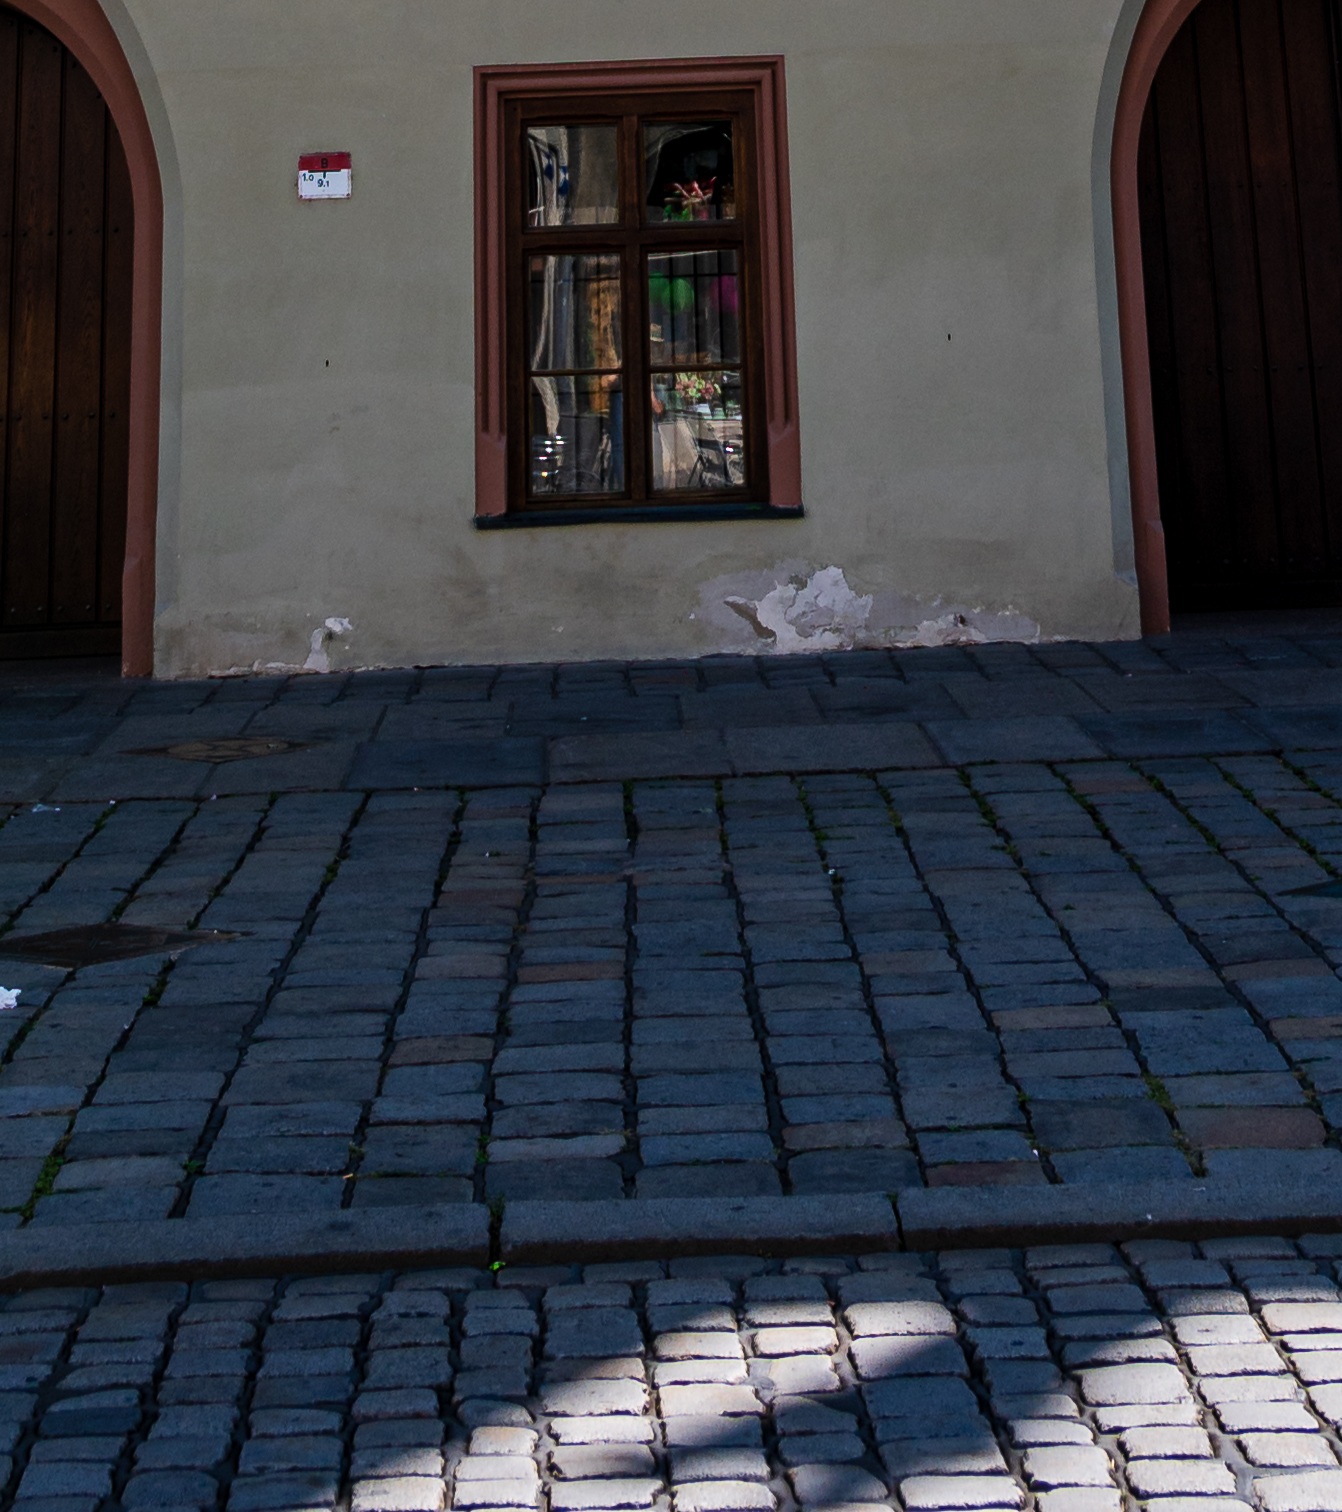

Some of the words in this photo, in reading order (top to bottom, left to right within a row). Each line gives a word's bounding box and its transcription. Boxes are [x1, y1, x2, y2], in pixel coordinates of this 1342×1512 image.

[321, 157, 328, 168] B
[302, 172, 314, 182] 1.0
[317, 178, 330, 188] 9.1
